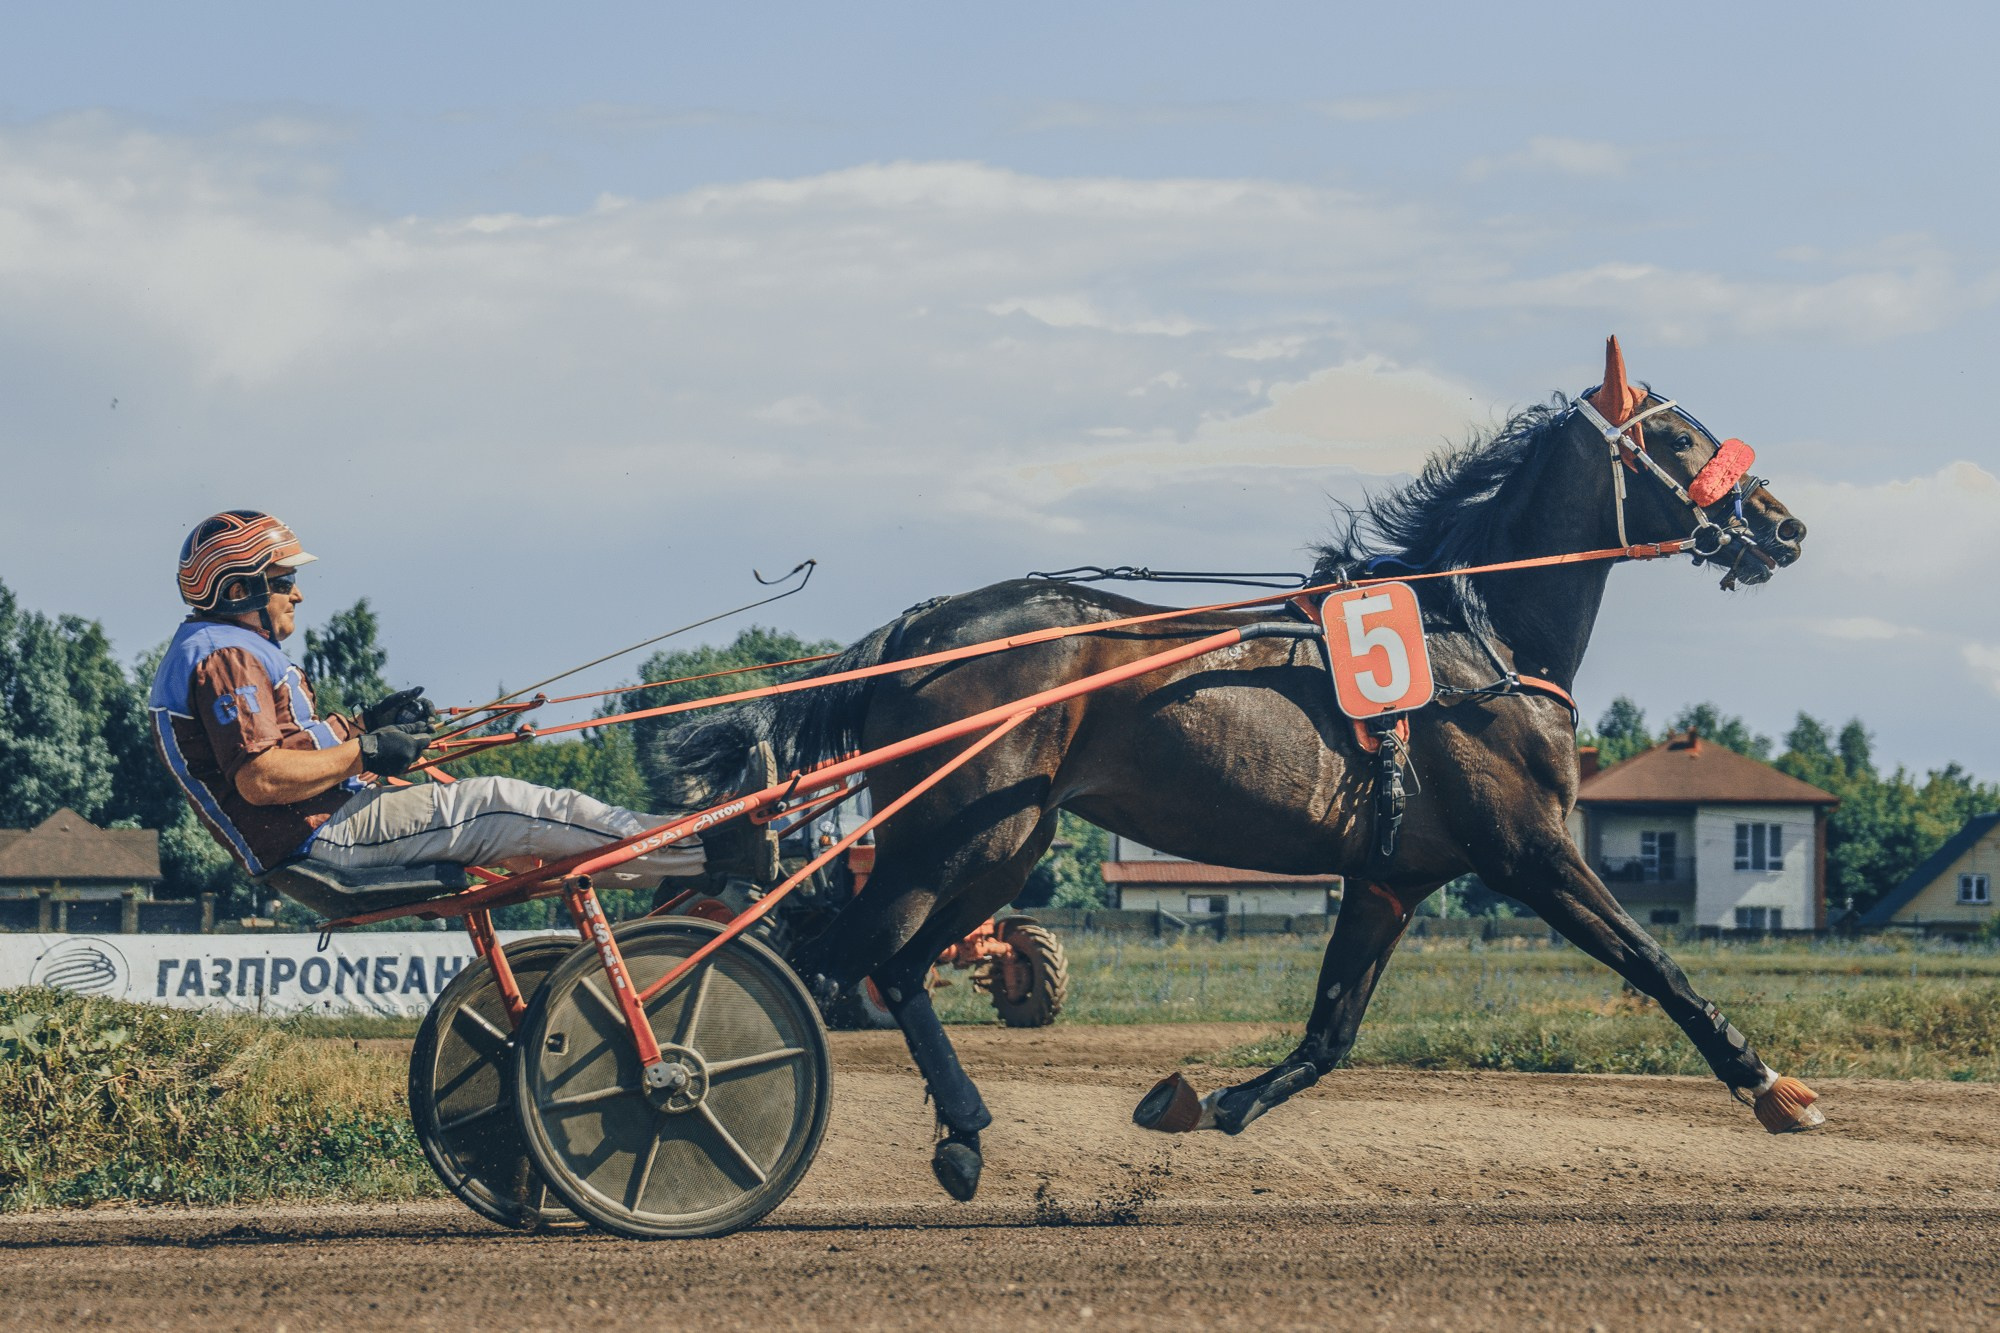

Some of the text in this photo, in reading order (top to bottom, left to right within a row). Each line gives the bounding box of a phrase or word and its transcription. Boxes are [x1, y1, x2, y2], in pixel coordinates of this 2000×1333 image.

[1342, 593, 1411, 704] 5
[692, 800, 746, 833] Arrow
[156, 955, 477, 997] ГАЗПРОМБАН
